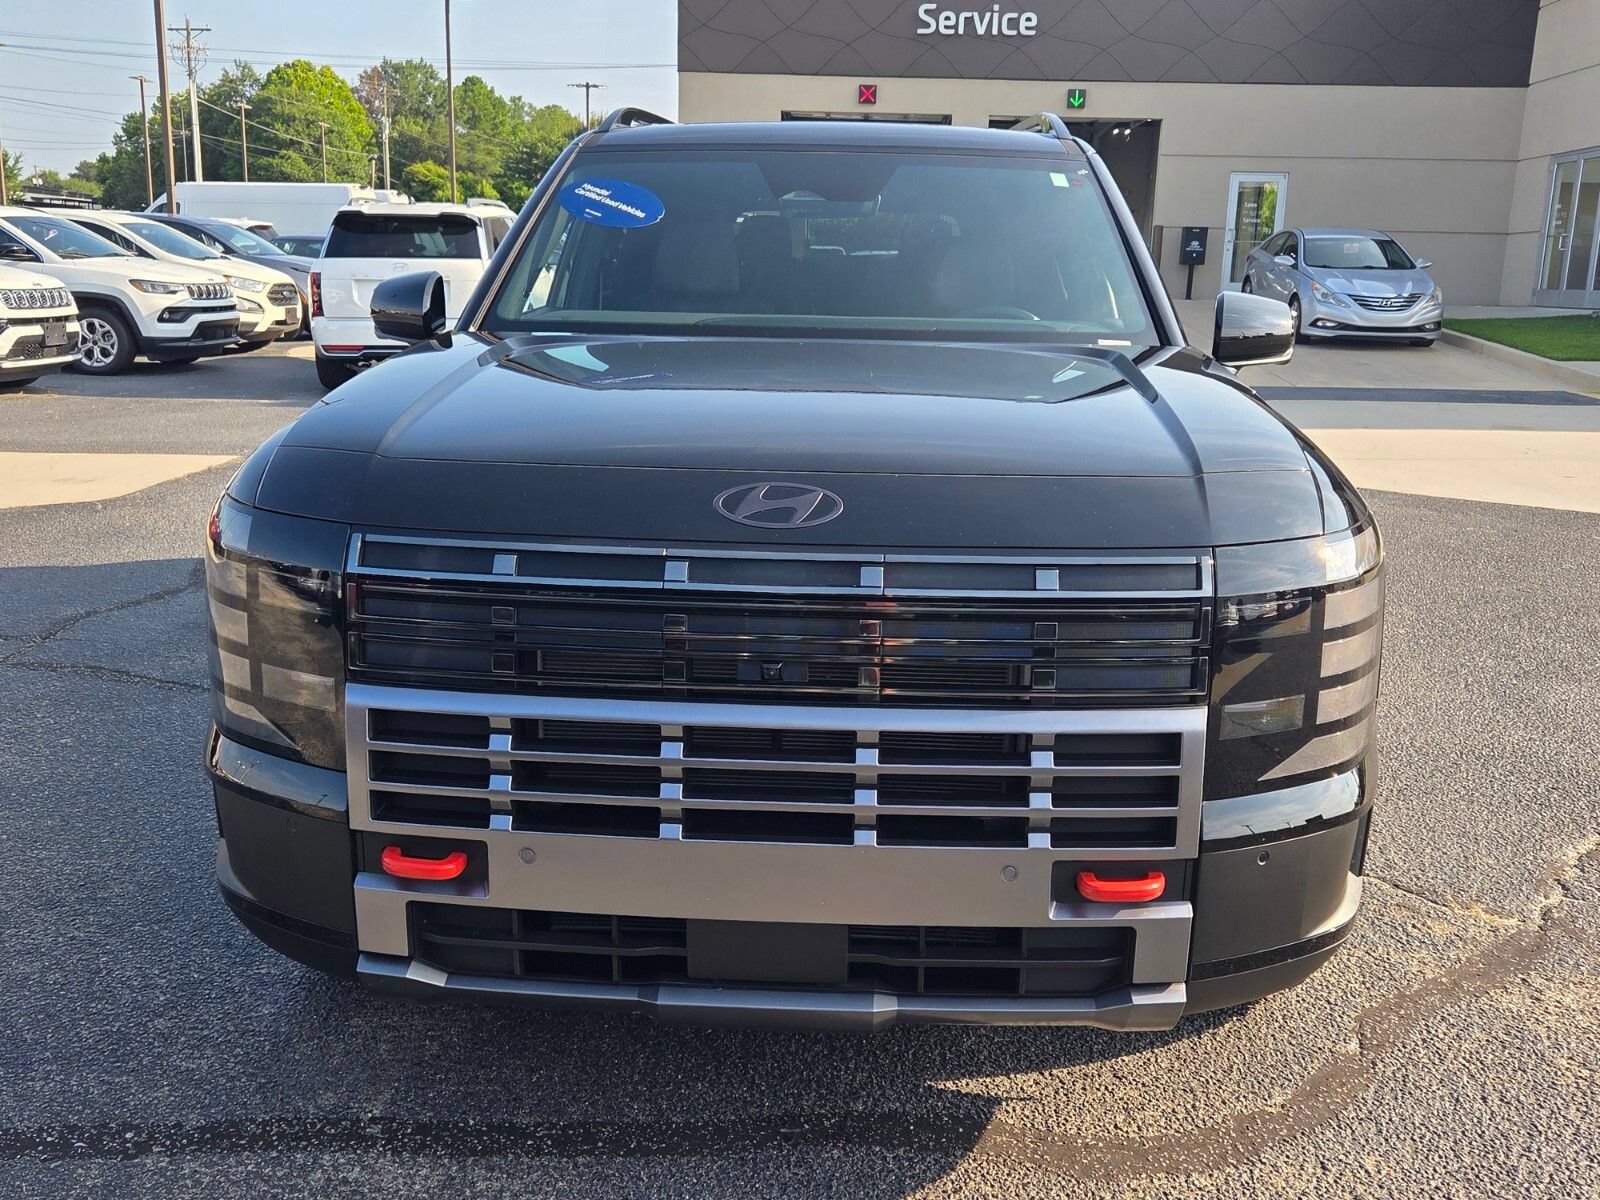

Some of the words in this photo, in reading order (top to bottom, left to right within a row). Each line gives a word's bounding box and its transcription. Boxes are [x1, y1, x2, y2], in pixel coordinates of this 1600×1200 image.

[916, 3, 1038, 36] Service
[575, 187, 602, 201] Certified
[601, 196, 621, 208] Used
[619, 203, 647, 218] Vehicles
[581, 183, 612, 196] Hyundai
